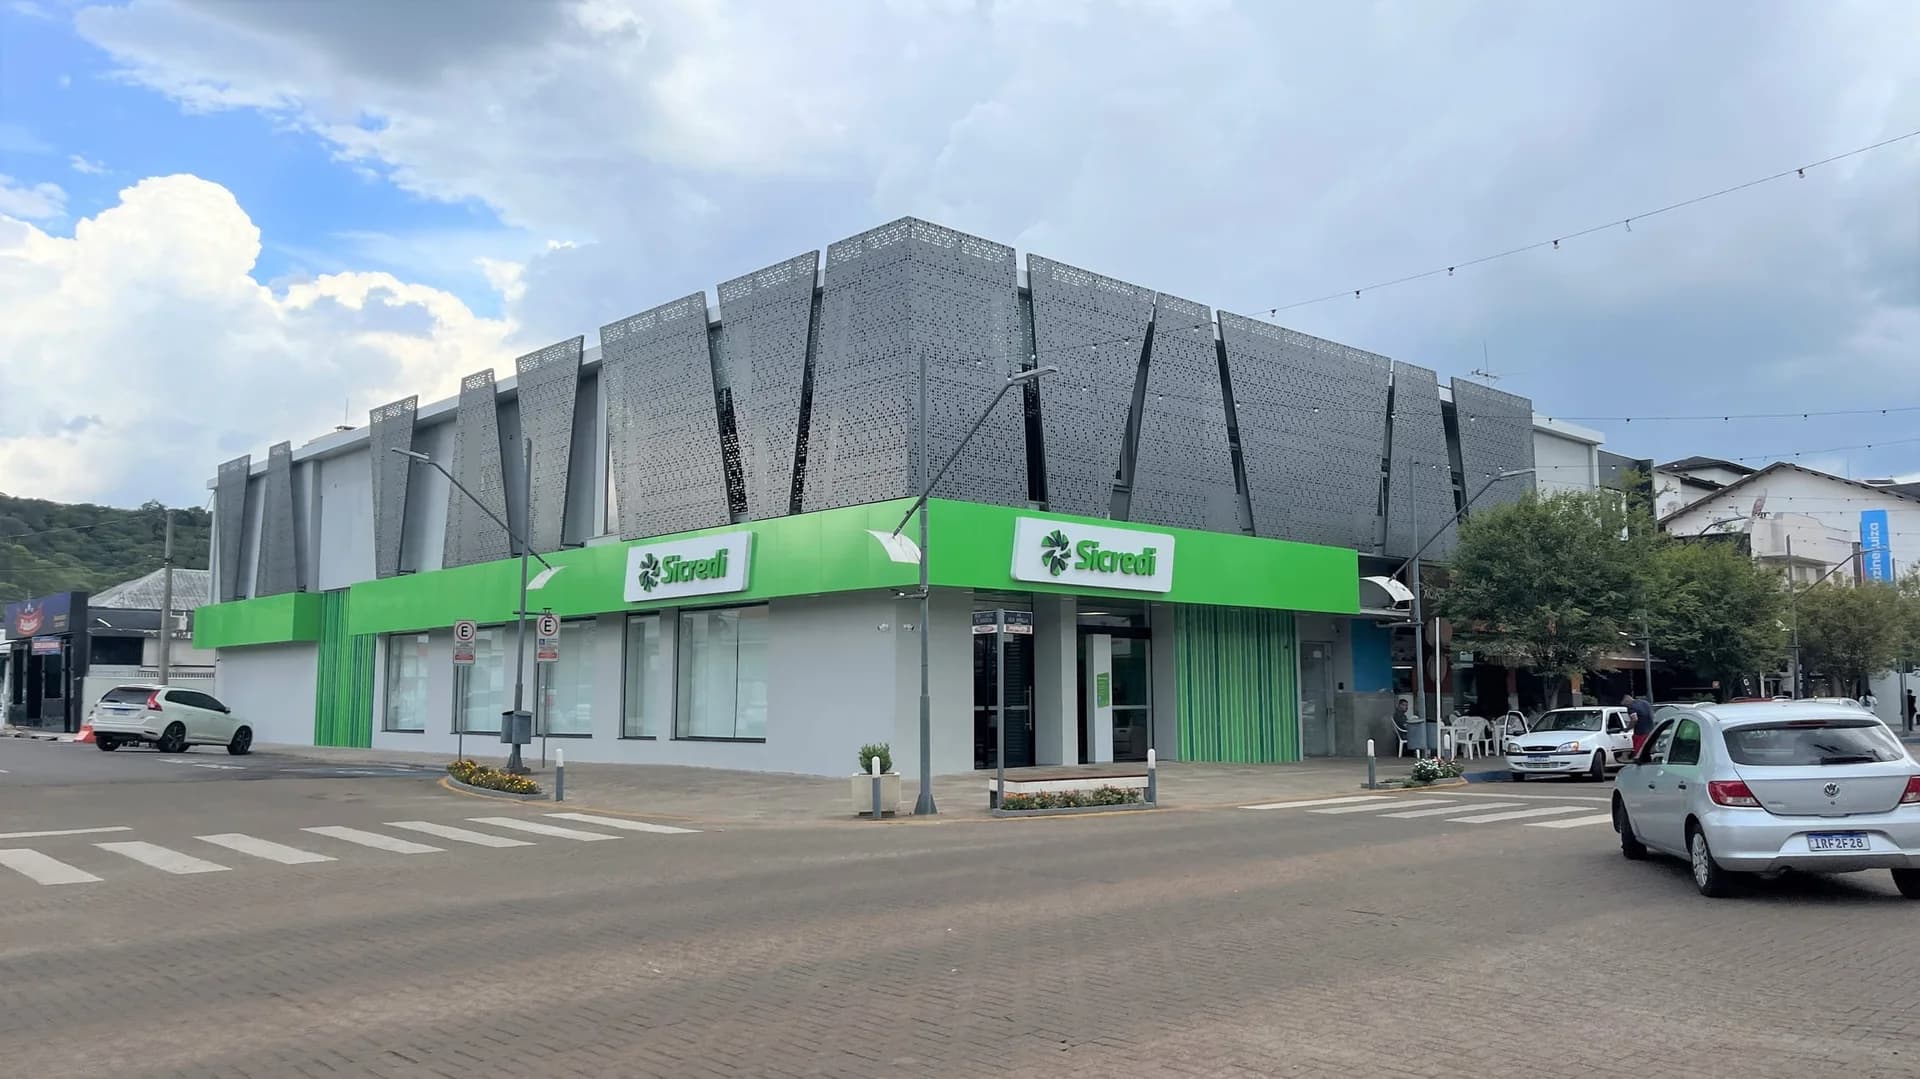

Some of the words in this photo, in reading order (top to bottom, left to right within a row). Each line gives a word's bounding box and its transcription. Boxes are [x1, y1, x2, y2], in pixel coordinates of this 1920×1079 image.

[661, 548, 729, 585] Sicredi
[1075, 540, 1157, 577] Sicredi
[461, 626, 469, 637] E
[544, 620, 552, 632] E
